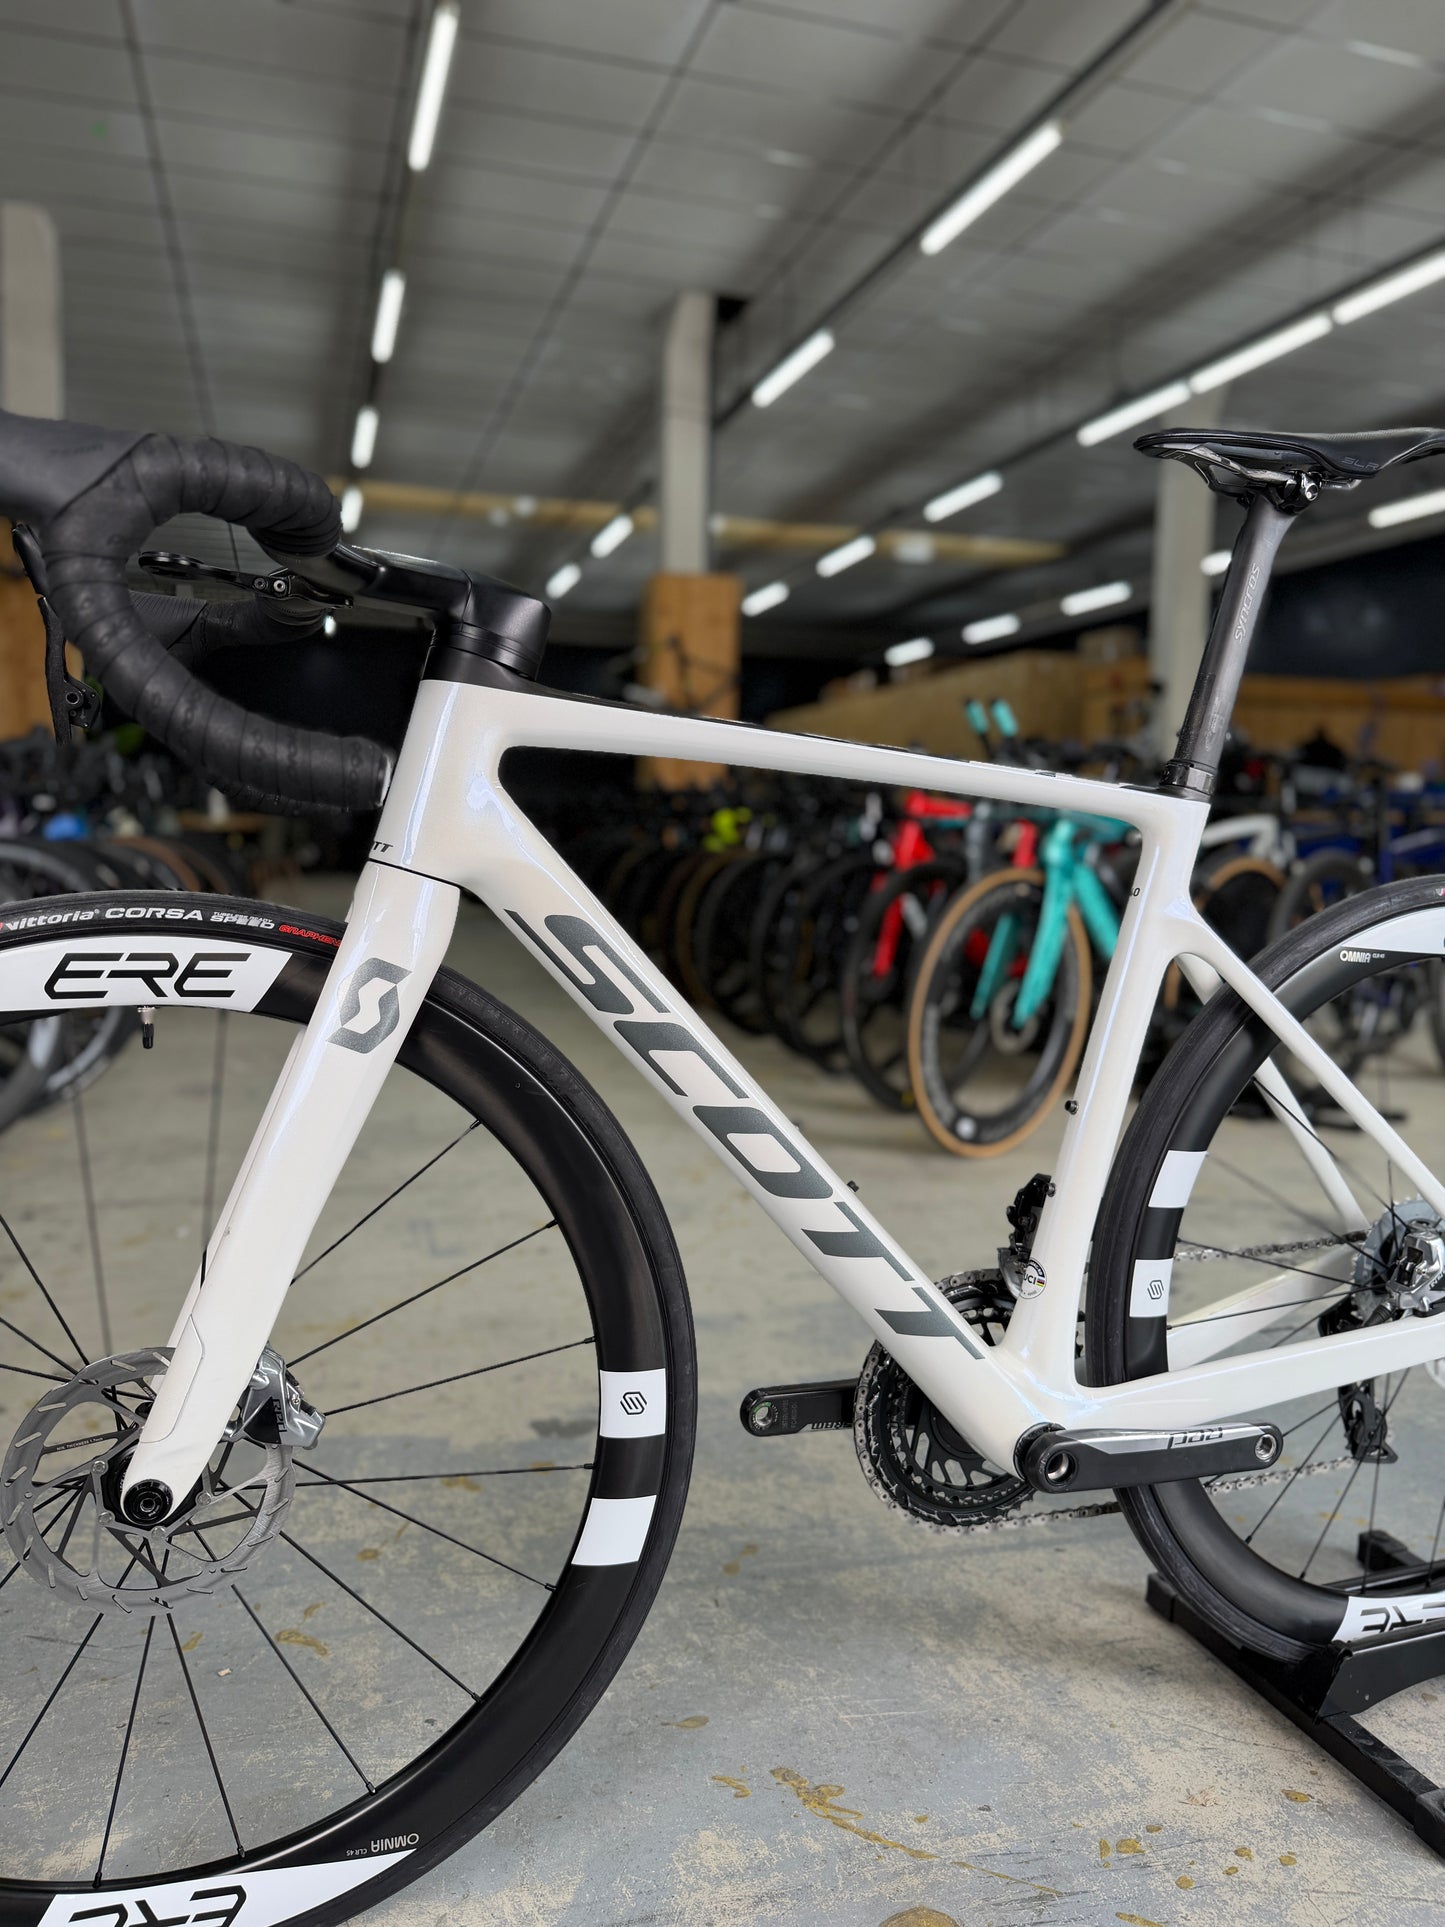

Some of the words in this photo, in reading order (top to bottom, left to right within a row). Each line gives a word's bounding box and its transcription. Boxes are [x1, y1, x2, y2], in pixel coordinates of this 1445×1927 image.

[1233, 564, 1261, 643] syncros
[104, 907, 203, 921] CORSA
[43, 952, 252, 1000] ERE
[503, 908, 986, 1361] SCOTT
[370, 1833, 420, 1853] OMNIA
